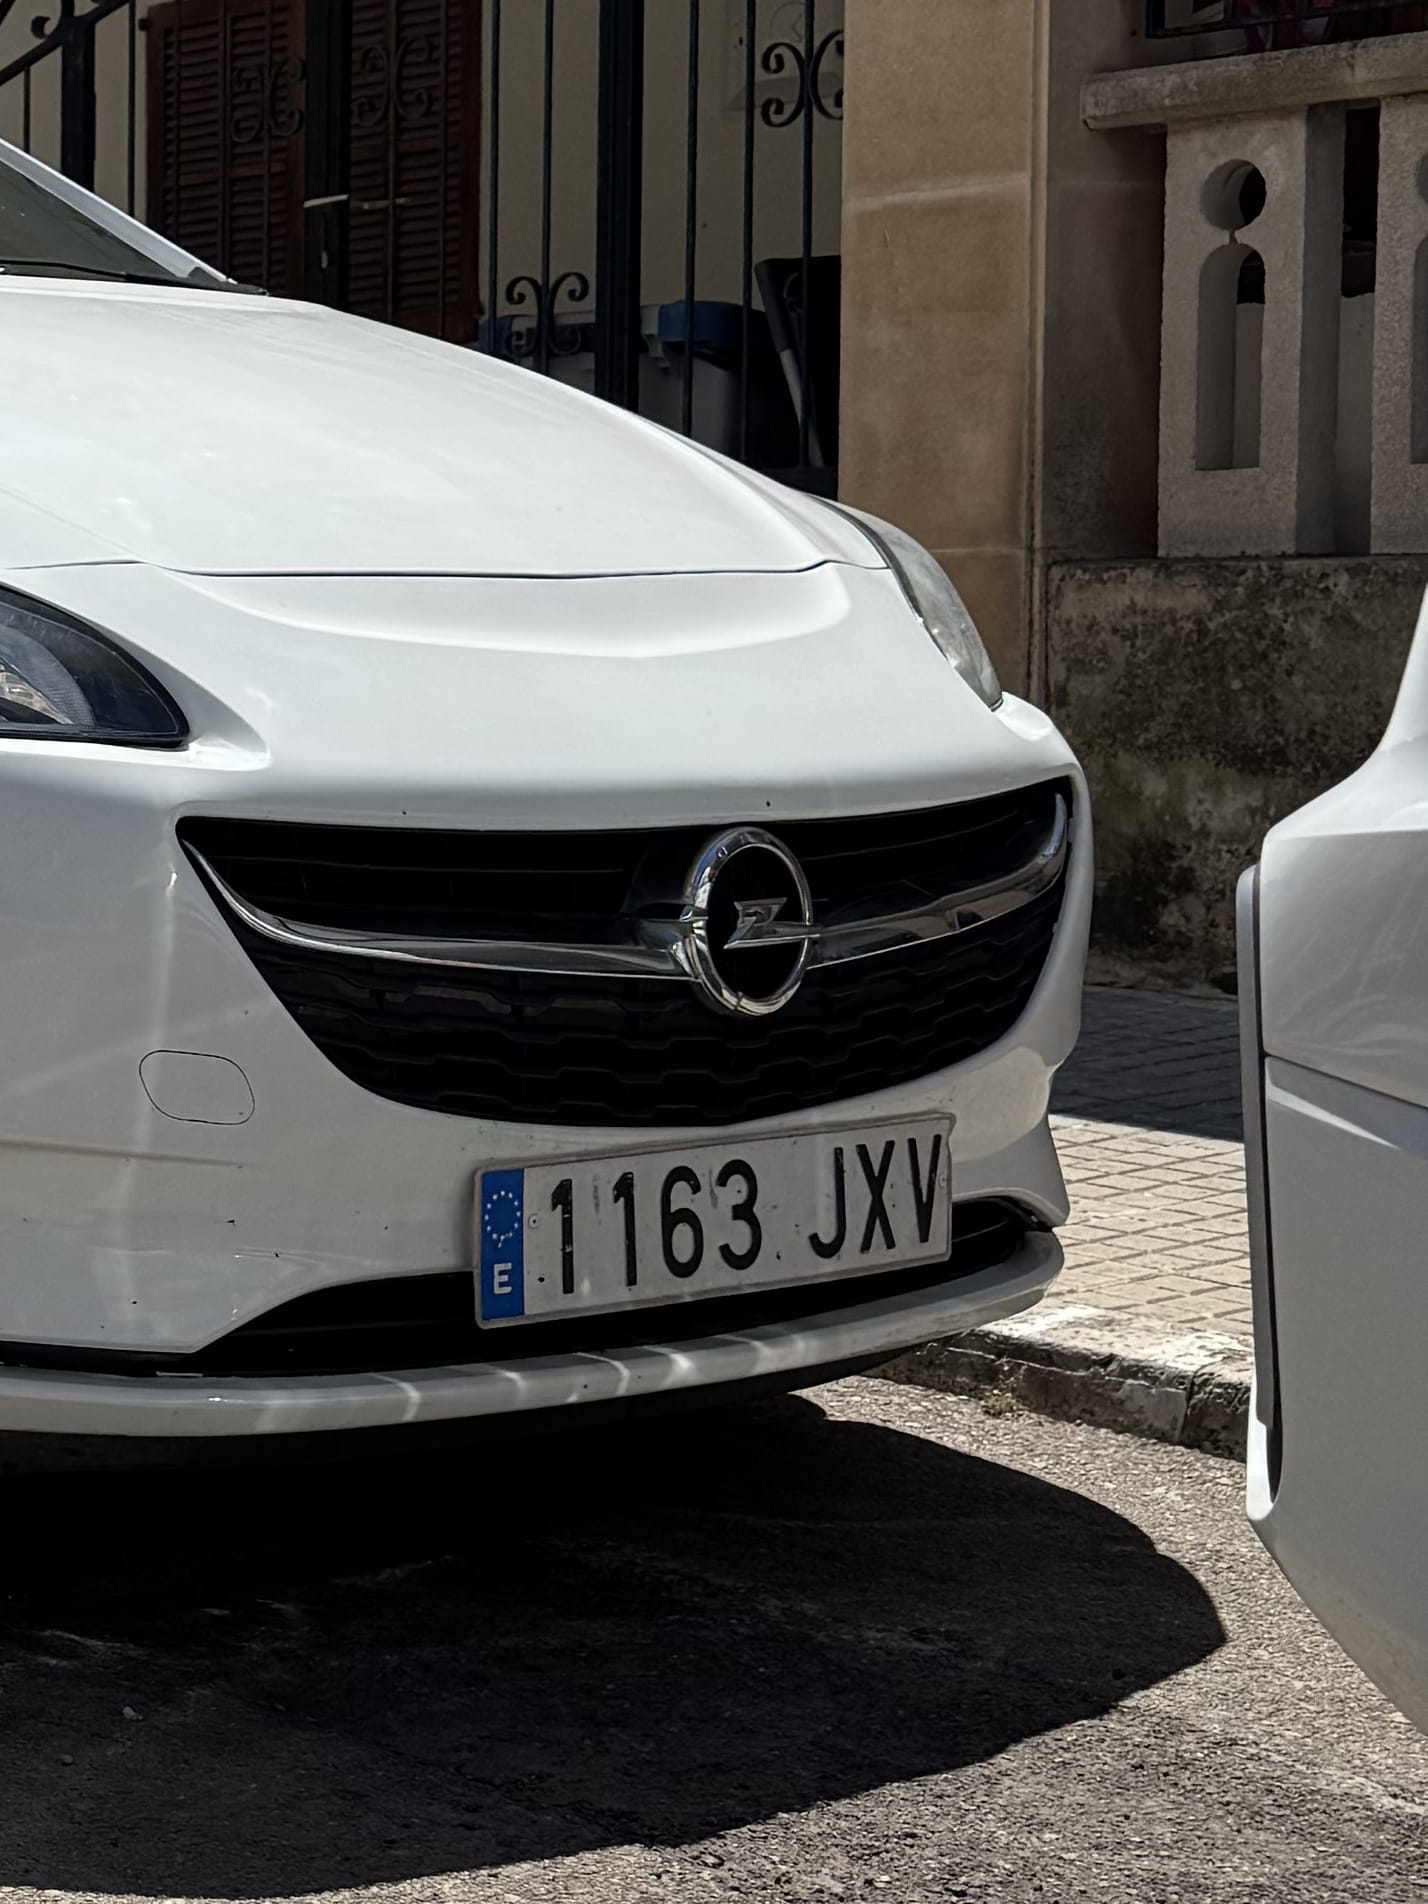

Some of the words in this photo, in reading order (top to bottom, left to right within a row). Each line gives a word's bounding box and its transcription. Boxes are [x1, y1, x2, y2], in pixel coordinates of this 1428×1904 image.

[550, 1158, 763, 1295] 1163
[808, 1133, 943, 1260] JXV
[492, 1262, 513, 1295] E
